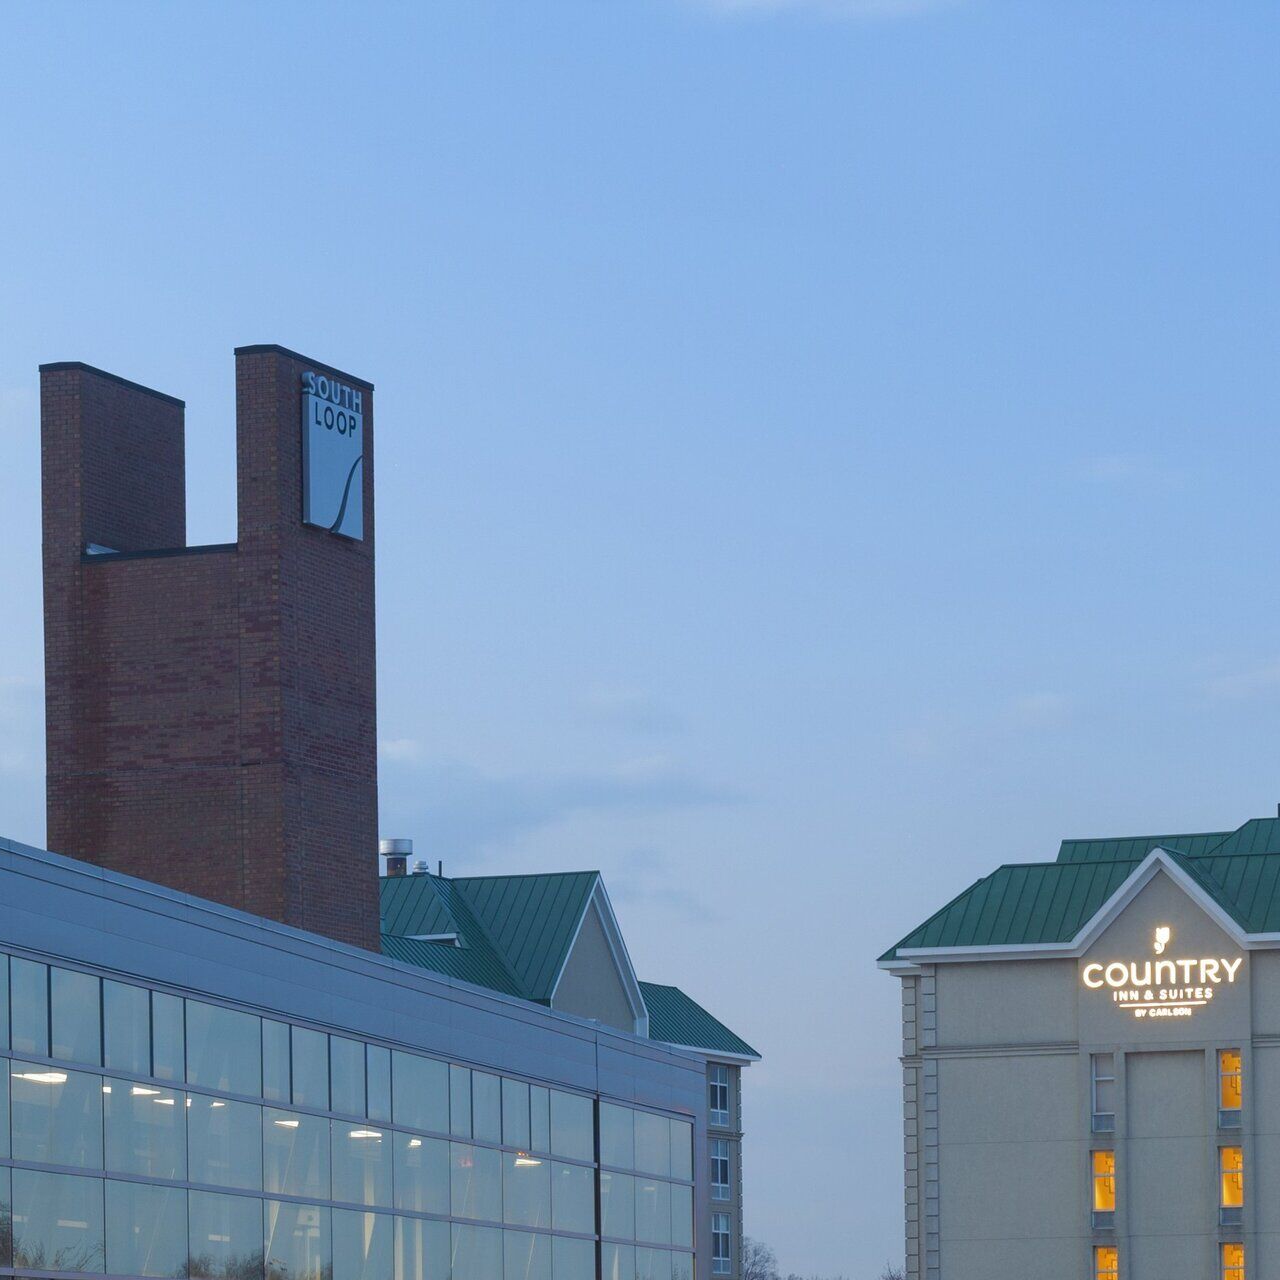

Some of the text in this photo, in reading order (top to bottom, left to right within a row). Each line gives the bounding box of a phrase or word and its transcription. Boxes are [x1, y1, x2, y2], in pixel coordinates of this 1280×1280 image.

[306, 371, 362, 415] SOUTH
[315, 402, 357, 438] LOOP
[1082, 957, 1243, 988] COUNTRY
[1113, 988, 1213, 1001] INN & SUITES
[1134, 1007, 1192, 1017] BY CARLSON
